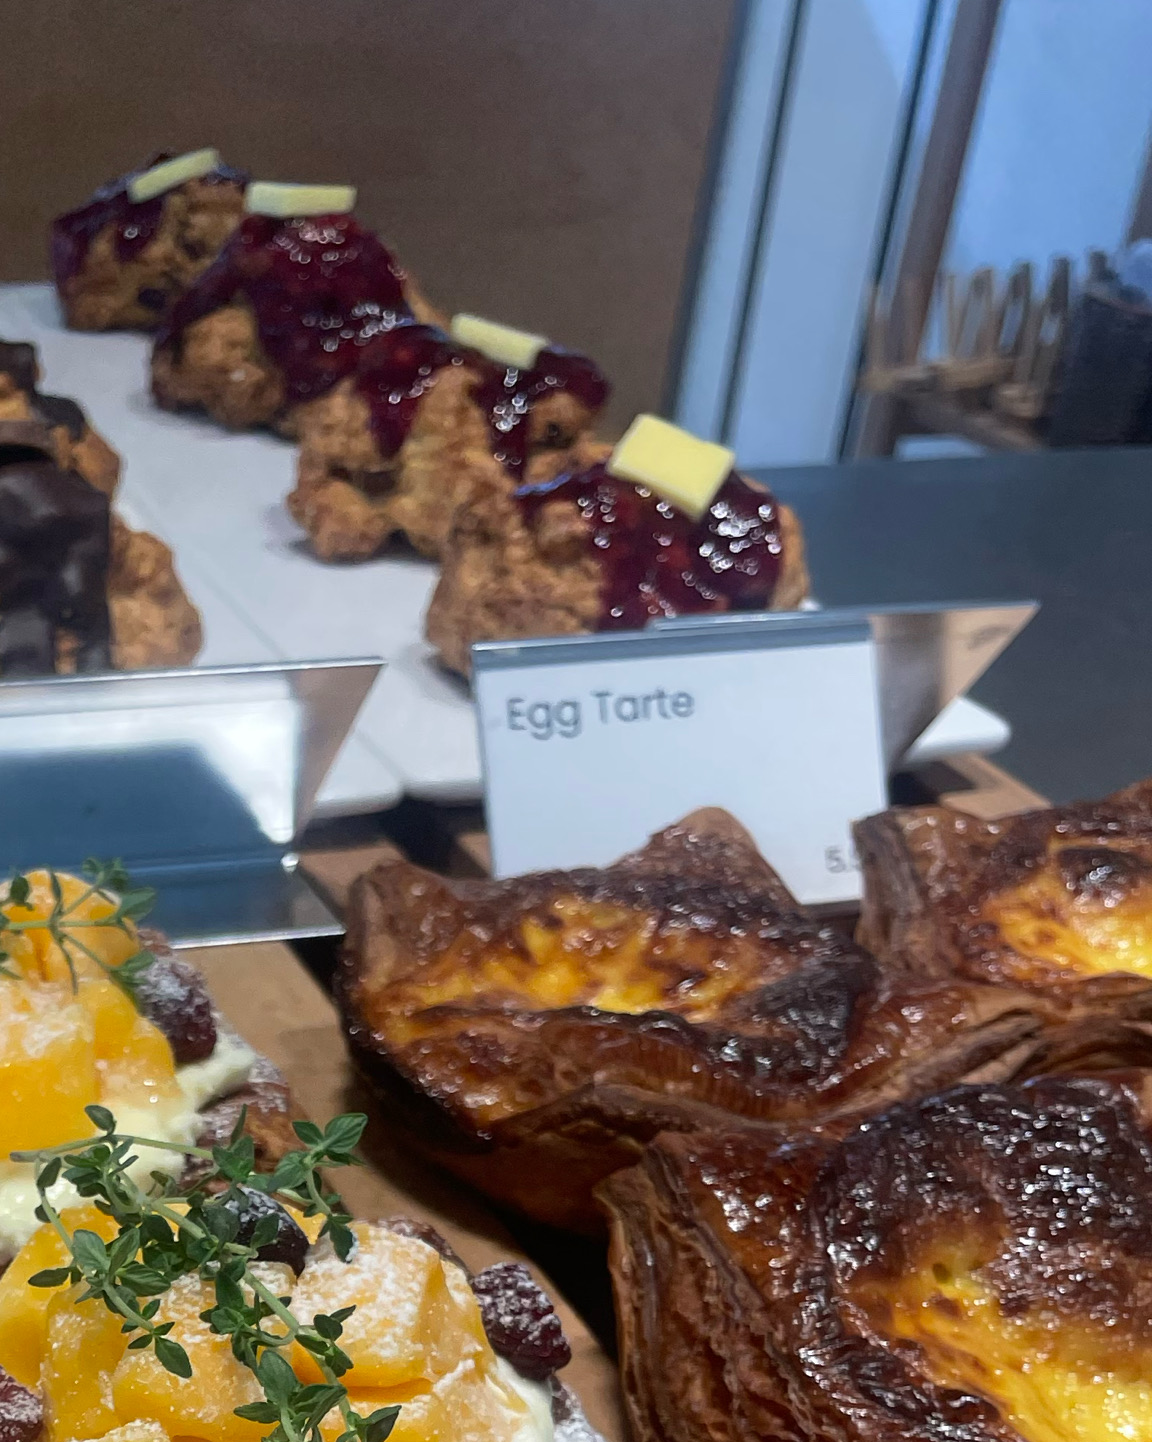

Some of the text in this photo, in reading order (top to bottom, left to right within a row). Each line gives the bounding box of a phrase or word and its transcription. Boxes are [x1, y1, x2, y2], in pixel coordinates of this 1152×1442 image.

[507, 686, 695, 741] Egg Tarte
[824, 845, 861, 874] 5.
